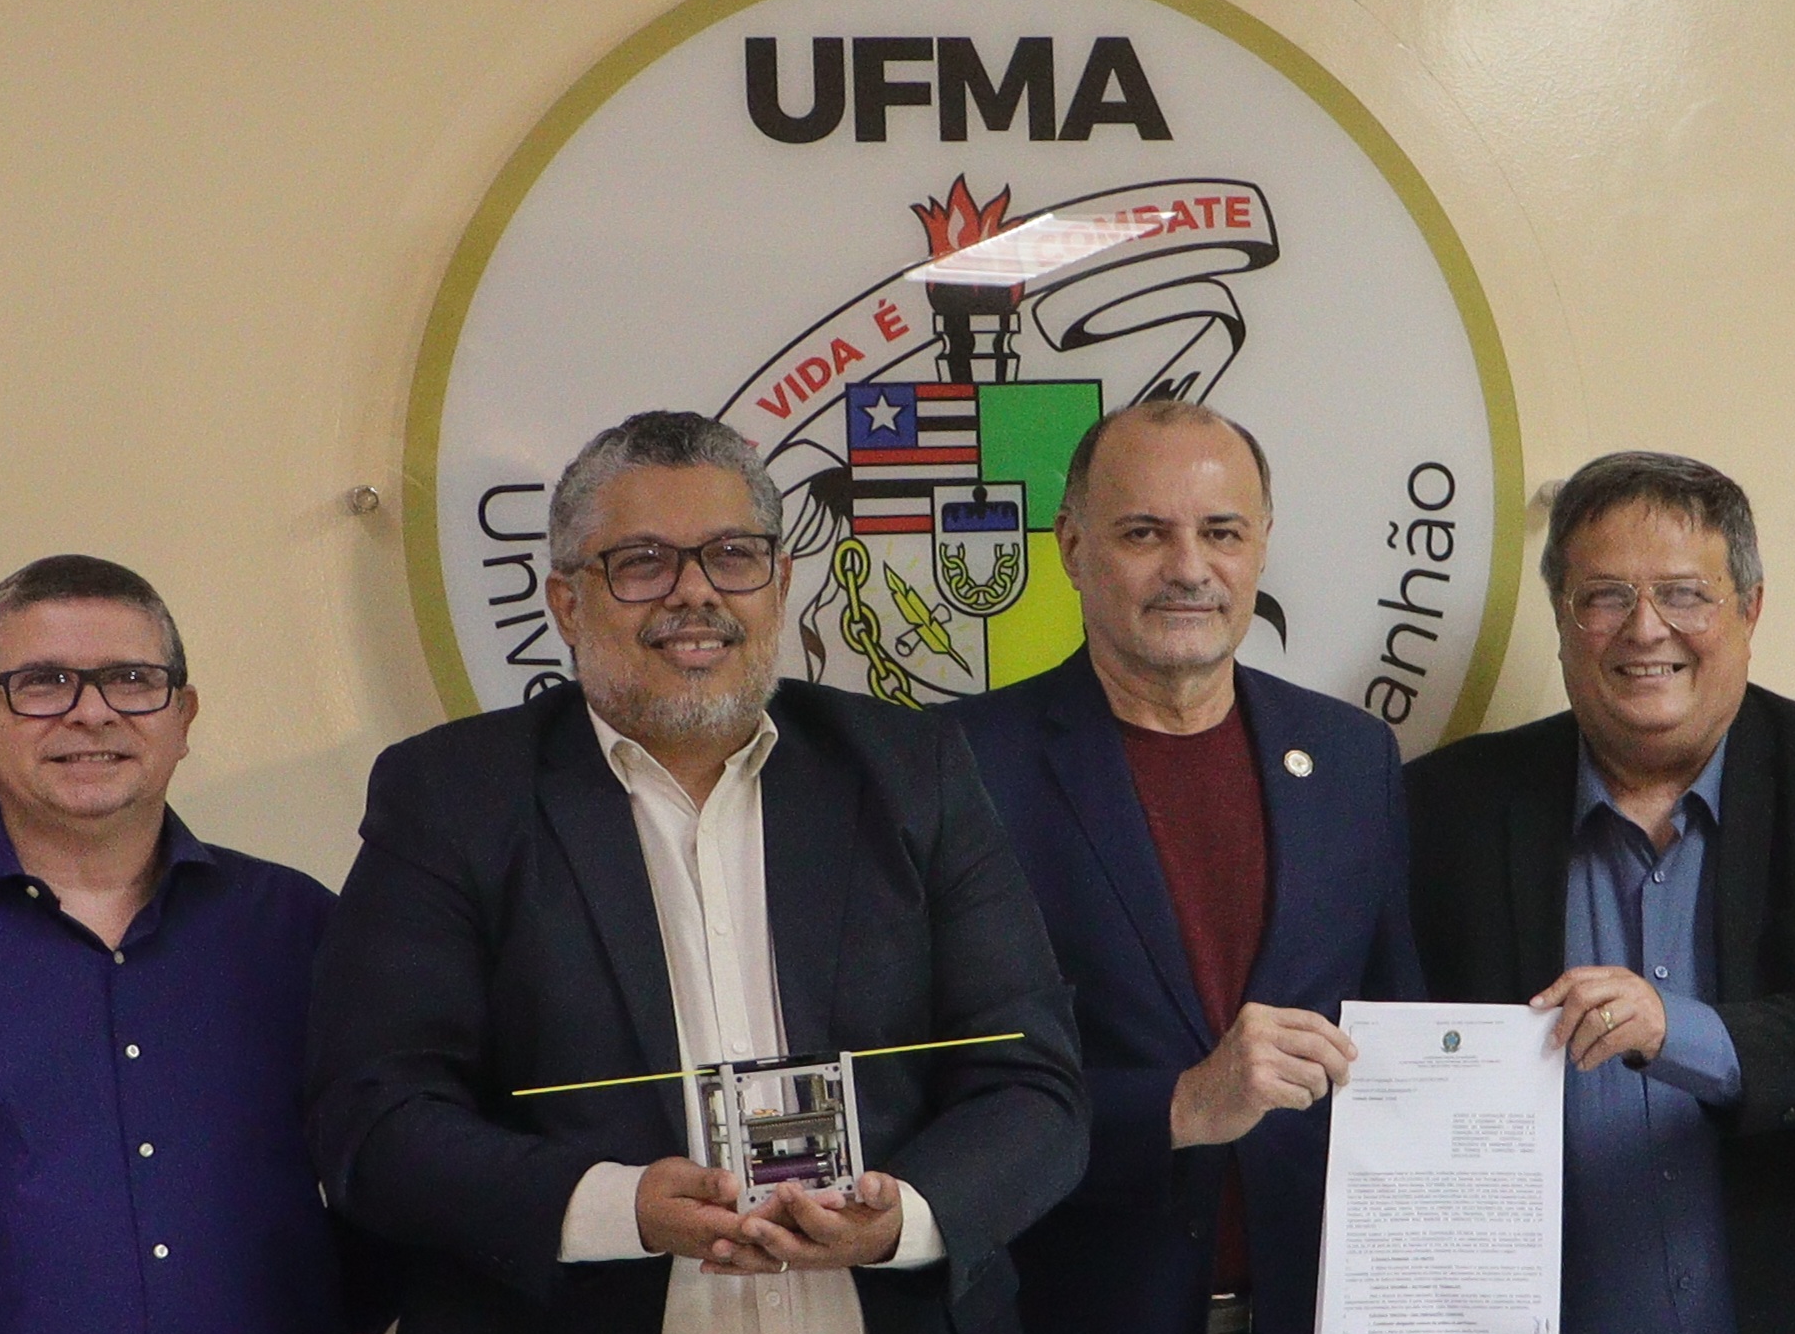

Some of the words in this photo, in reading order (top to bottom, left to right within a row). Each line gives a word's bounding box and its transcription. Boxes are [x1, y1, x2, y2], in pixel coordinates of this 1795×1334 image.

[744, 36, 1174, 144] UFMA
[756, 336, 866, 420] VIDA
[872, 298, 911, 343] É
[1036, 195, 1252, 266] COMBATE
[1364, 461, 1456, 725] anhão
